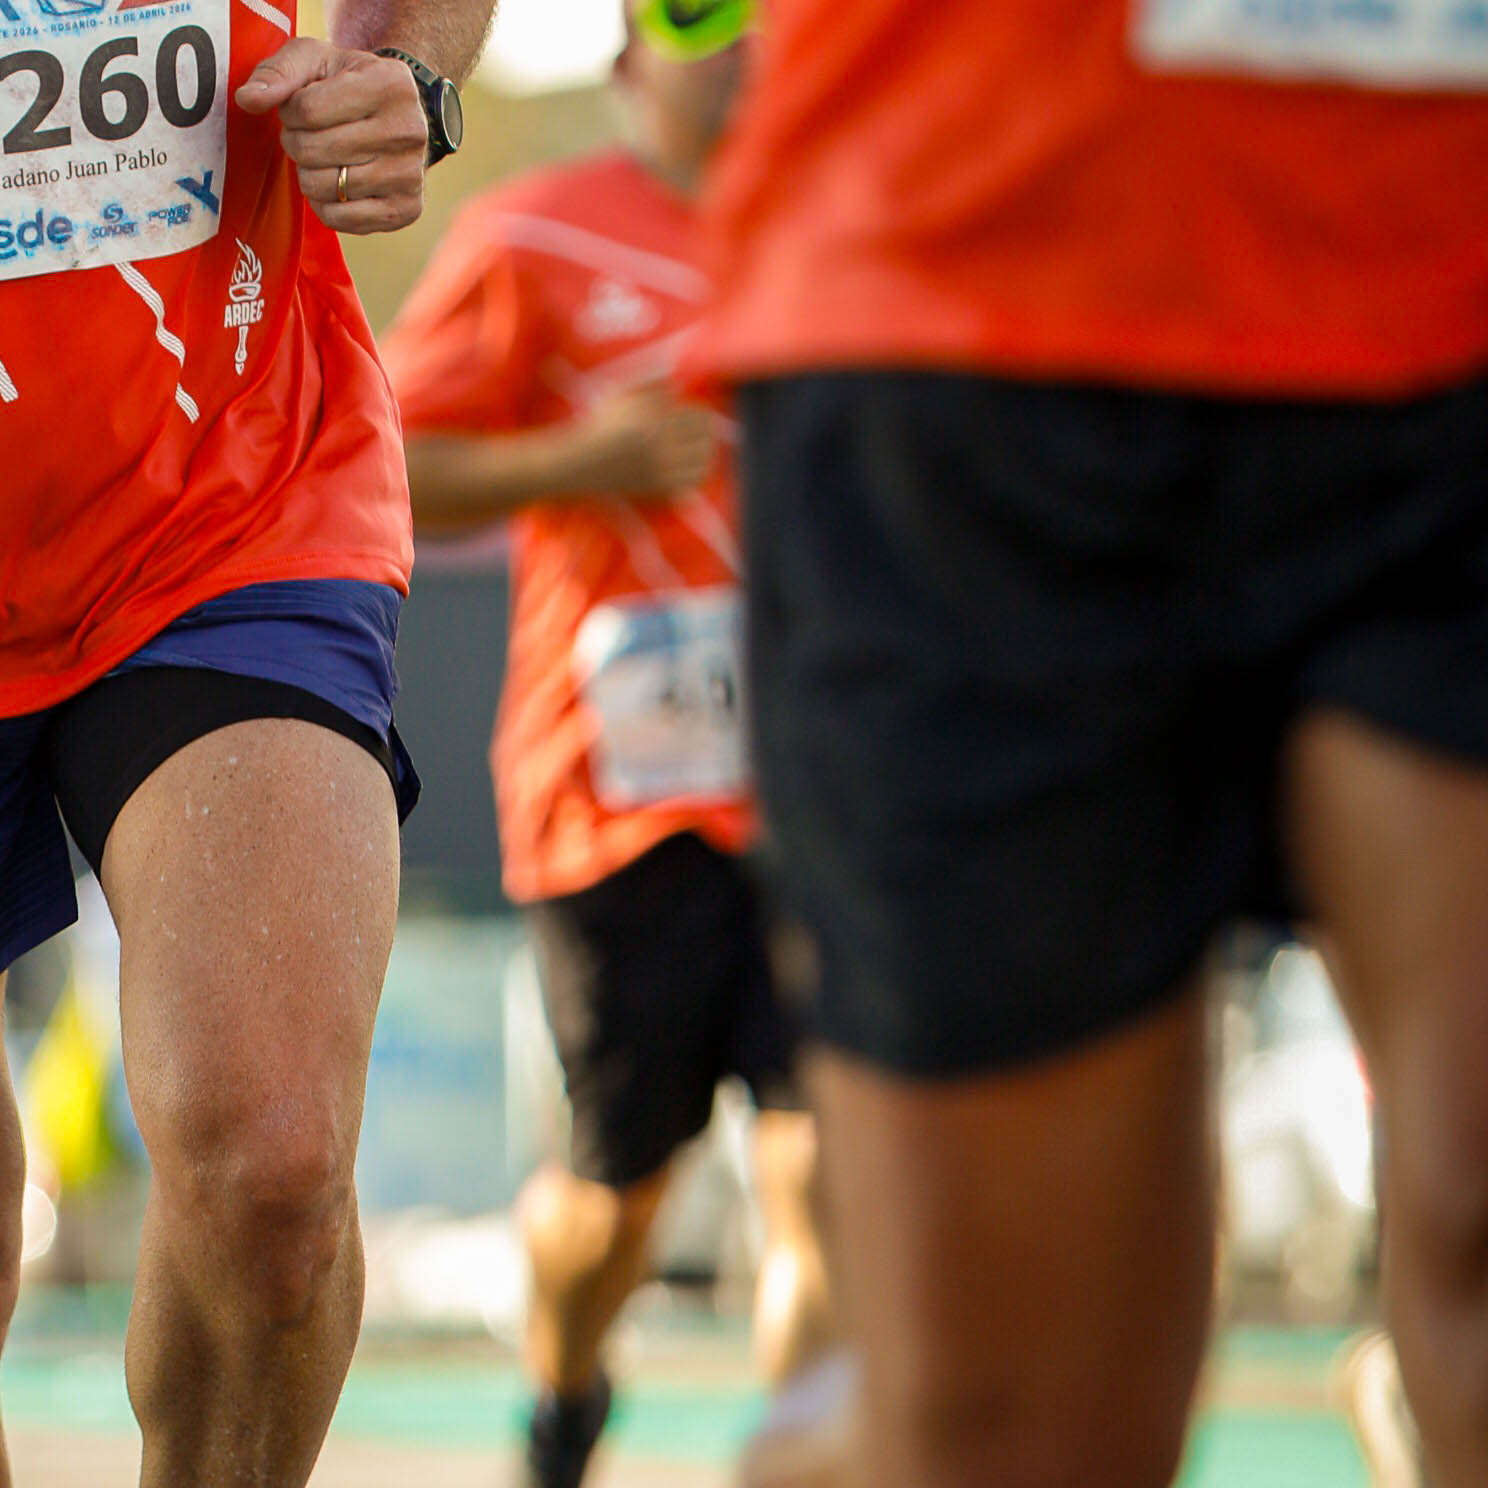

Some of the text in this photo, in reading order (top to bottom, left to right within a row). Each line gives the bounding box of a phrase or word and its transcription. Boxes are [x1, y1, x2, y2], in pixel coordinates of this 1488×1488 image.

[13, 26, 39, 38] 2026
[50, 19, 97, 33] ROSARIO
[108, 15, 119, 25] 12
[123, 12, 136, 23] DE
[139, 7, 166, 20] ABRIL
[65, 160, 109, 180] Juan
[114, 147, 169, 173] Pablo
